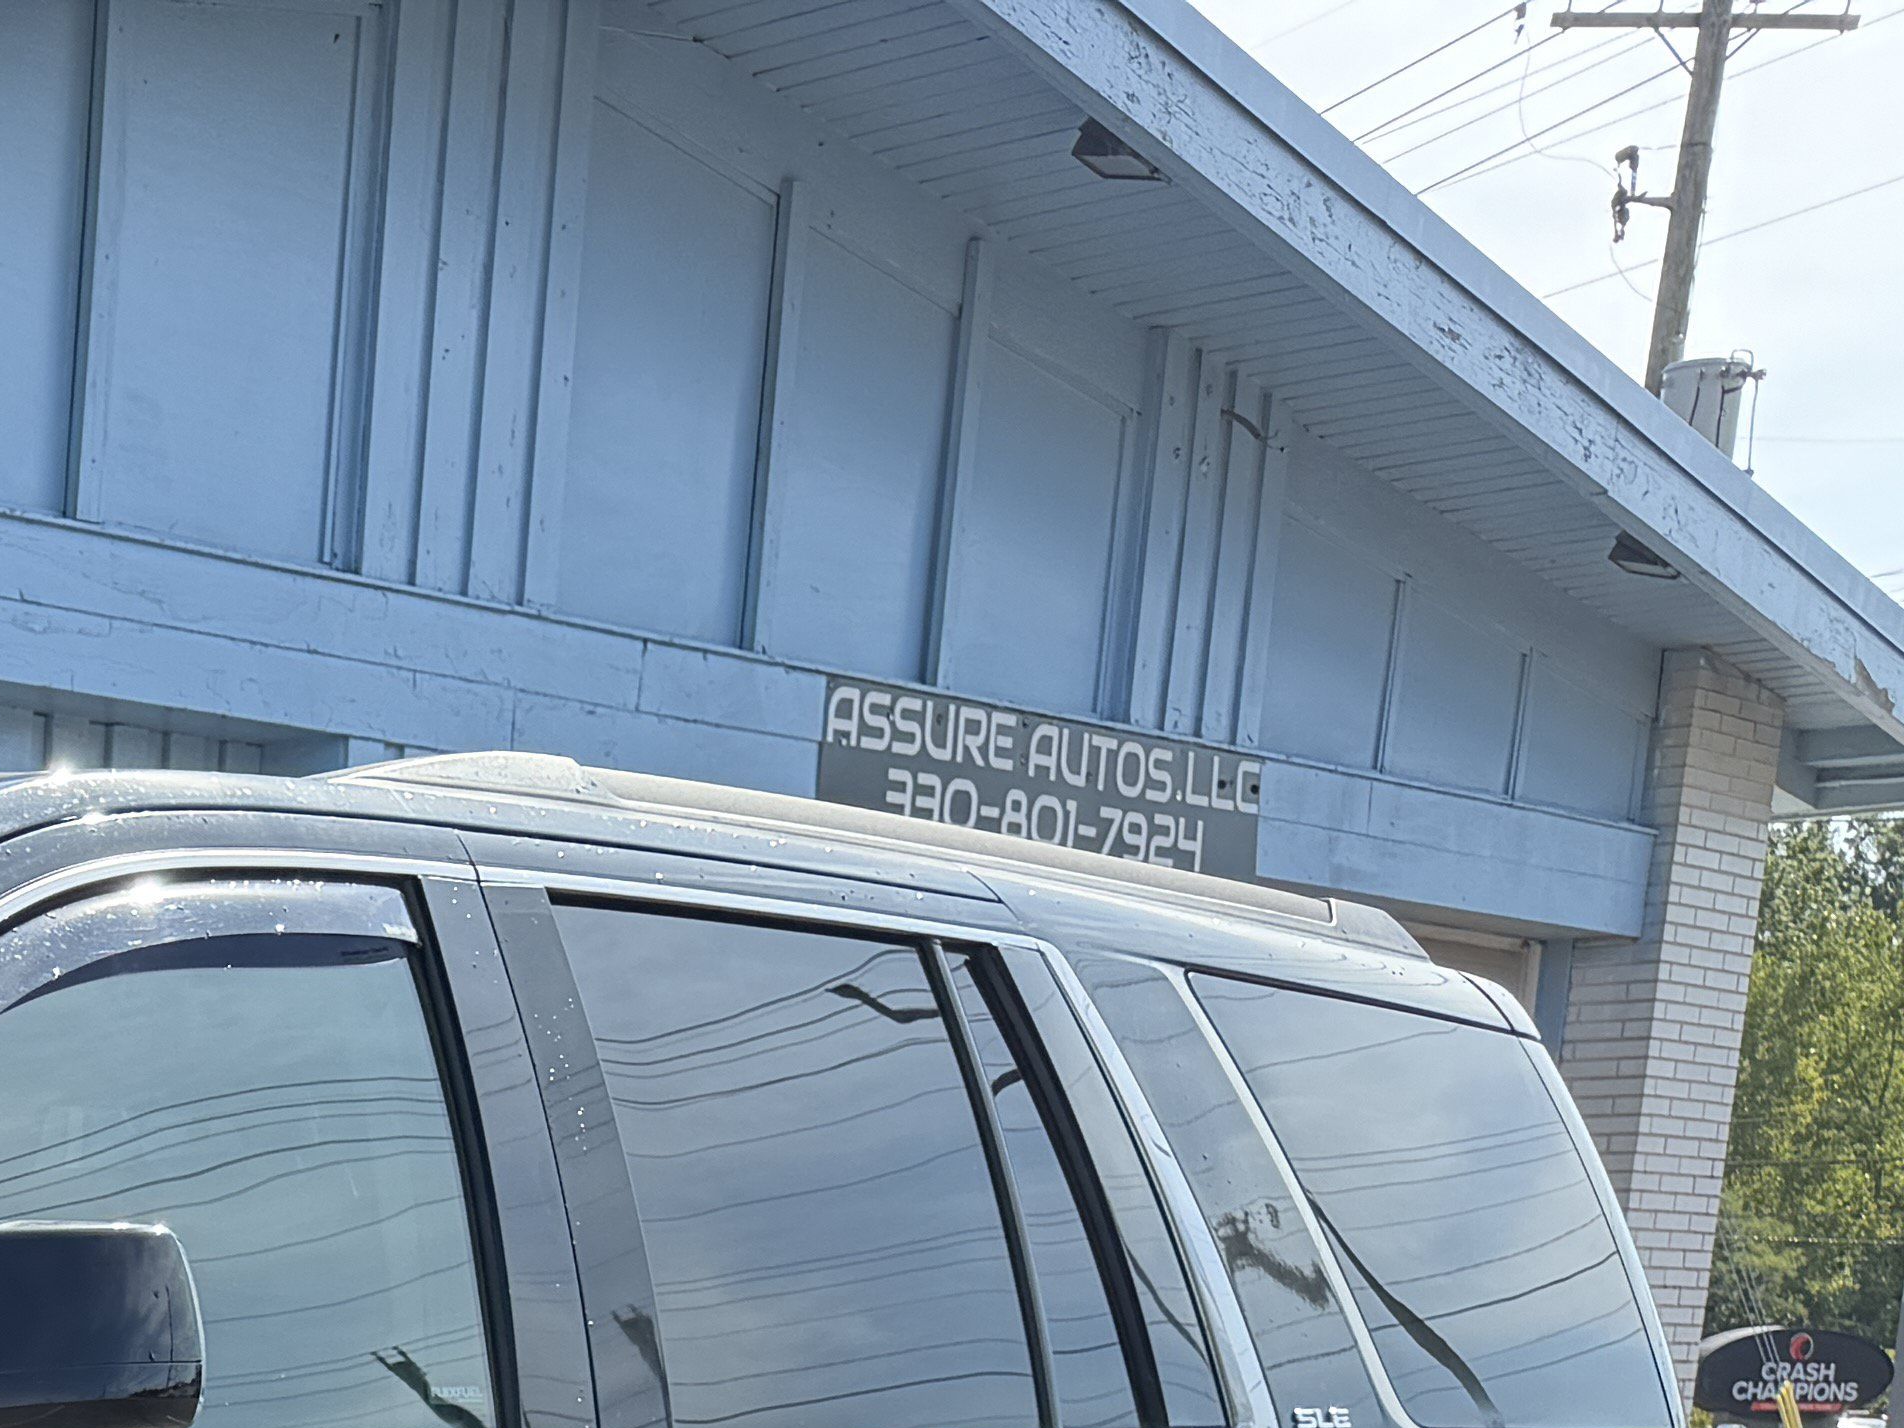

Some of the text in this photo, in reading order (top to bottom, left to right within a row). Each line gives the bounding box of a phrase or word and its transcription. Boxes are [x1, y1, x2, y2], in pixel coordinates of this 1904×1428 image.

[826, 686, 1018, 771] ASSURE
[885, 767, 1204, 873] 330-801-7924
[1732, 1381, 1859, 1402] CHAPIONS
[1761, 1361, 1836, 1381] CRASH
